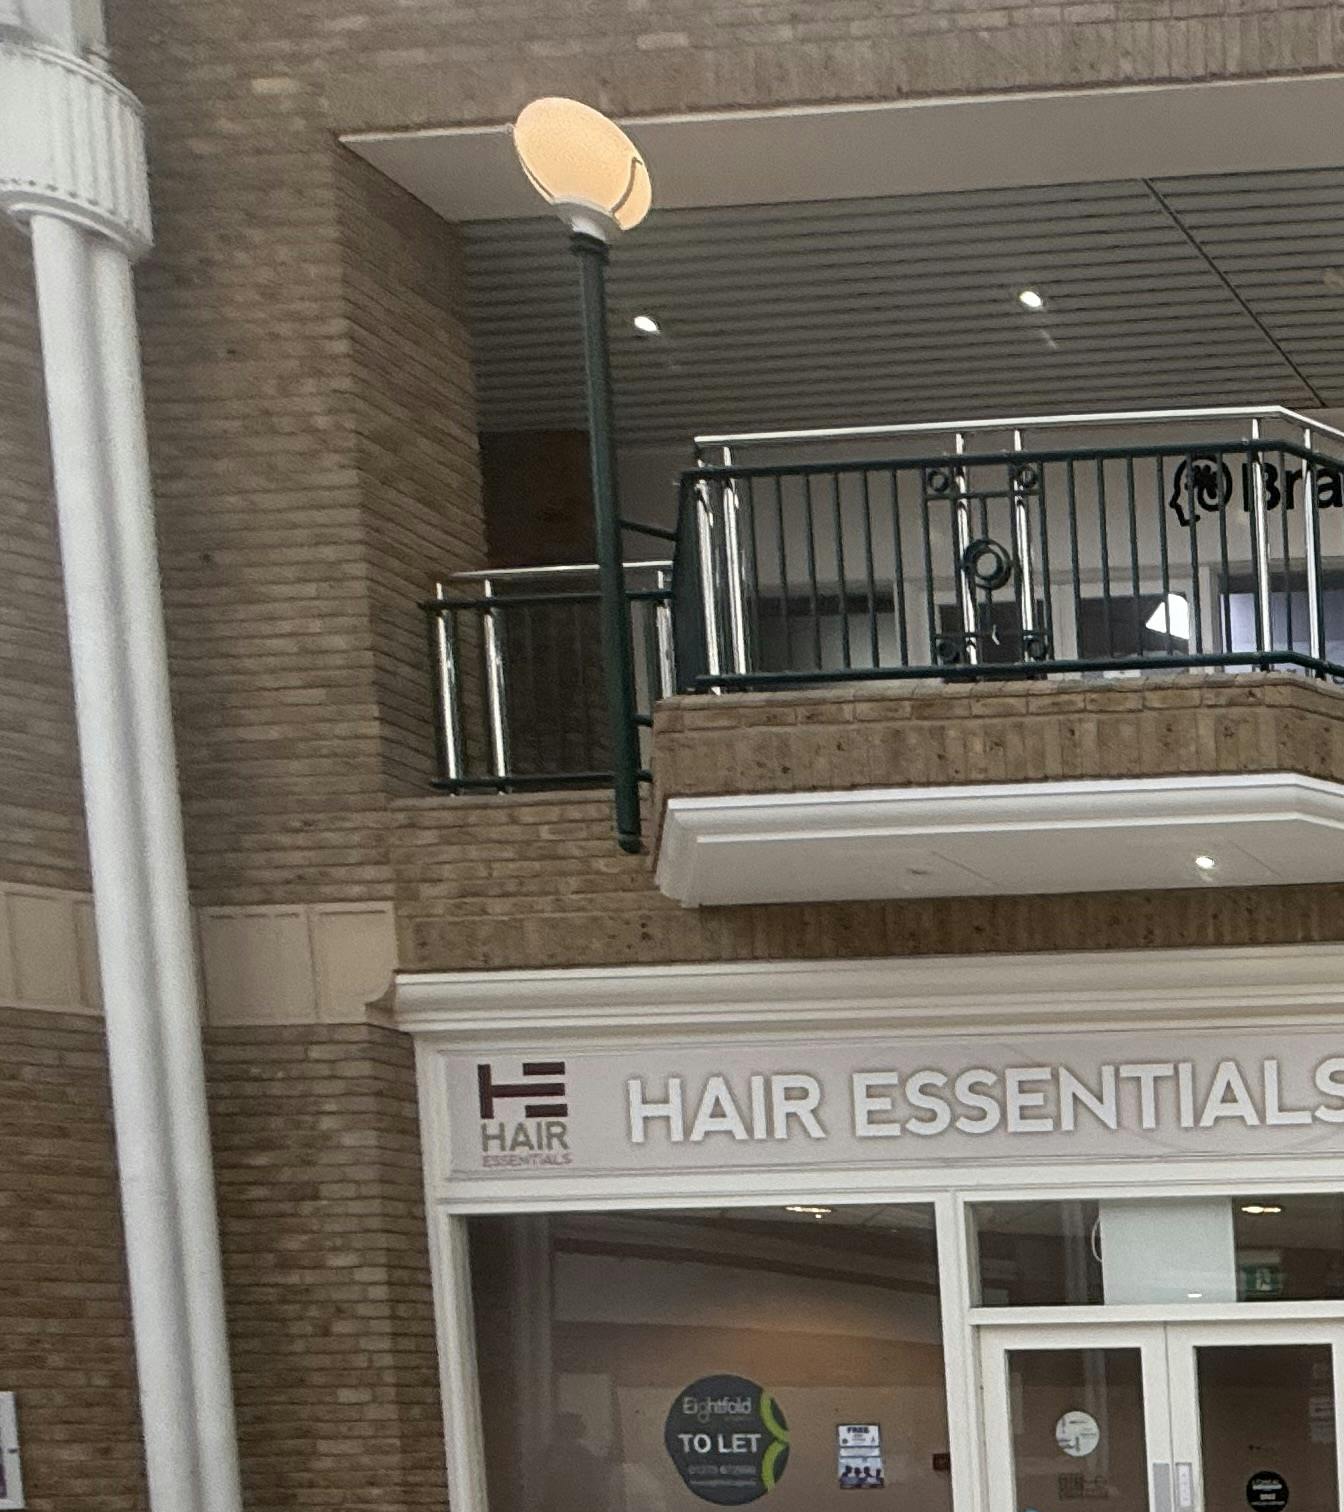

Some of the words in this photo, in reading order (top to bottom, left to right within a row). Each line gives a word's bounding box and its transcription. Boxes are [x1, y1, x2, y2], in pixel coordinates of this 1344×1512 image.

[627, 1074, 827, 1143] HAIR
[481, 1120, 570, 1152] HAIR
[482, 1152, 573, 1168] ESSENTIALS
[677, 1433, 712, 1454] TO
[717, 1433, 762, 1454] LET
